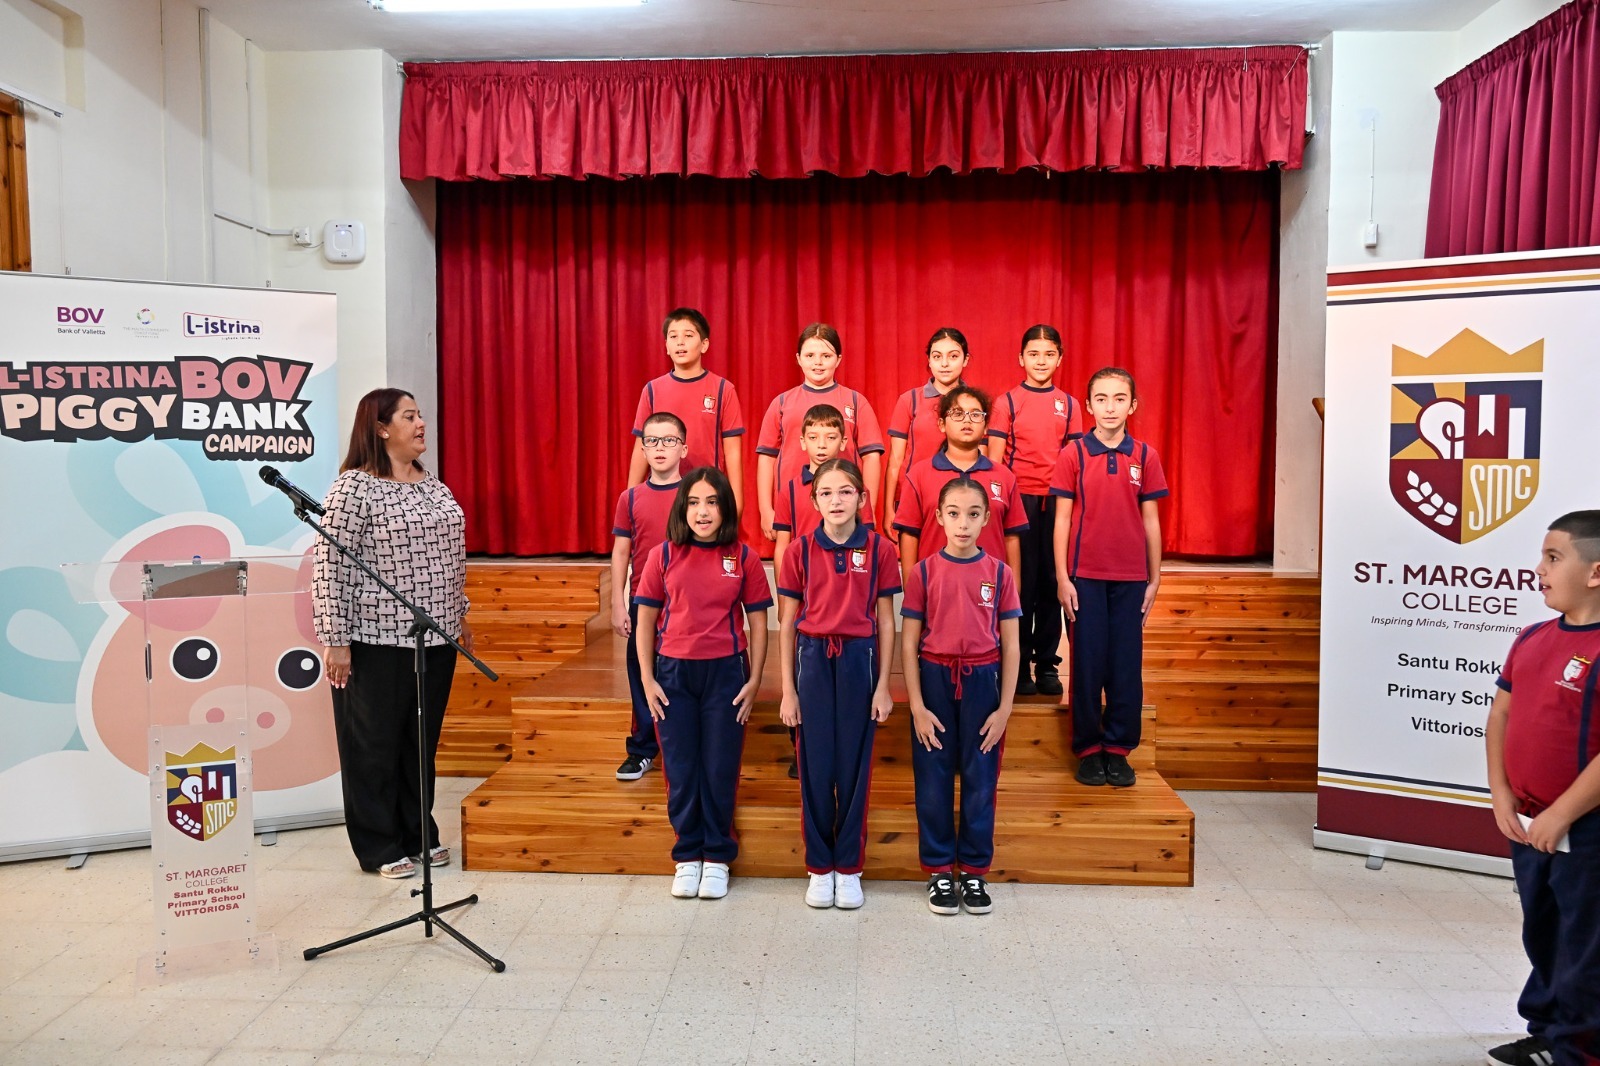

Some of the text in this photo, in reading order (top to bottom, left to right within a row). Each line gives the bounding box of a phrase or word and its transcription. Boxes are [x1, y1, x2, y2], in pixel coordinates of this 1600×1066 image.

[57, 307, 104, 323] BOV
[0, 360, 306, 400] L-ISTRINA BOV
[1, 394, 303, 431] PIGGY BANK
[205, 434, 312, 454] CAMPAIGN
[1354, 562, 1543, 591] ST. MARGAR
[1402, 592, 1517, 615] COLLEGE
[1370, 615, 1522, 635] Inspiring Minds, Transforming
[1397, 653, 1503, 675] Santu Rokk
[1388, 683, 1494, 706] Primary Sch
[165, 863, 247, 881] ST. MARGARET
[185, 876, 228, 888] COLLEGE
[167, 892, 246, 910] Primary School
[173, 884, 239, 899] Santu Rokku
[174, 903, 239, 917] VITTORIOSA
